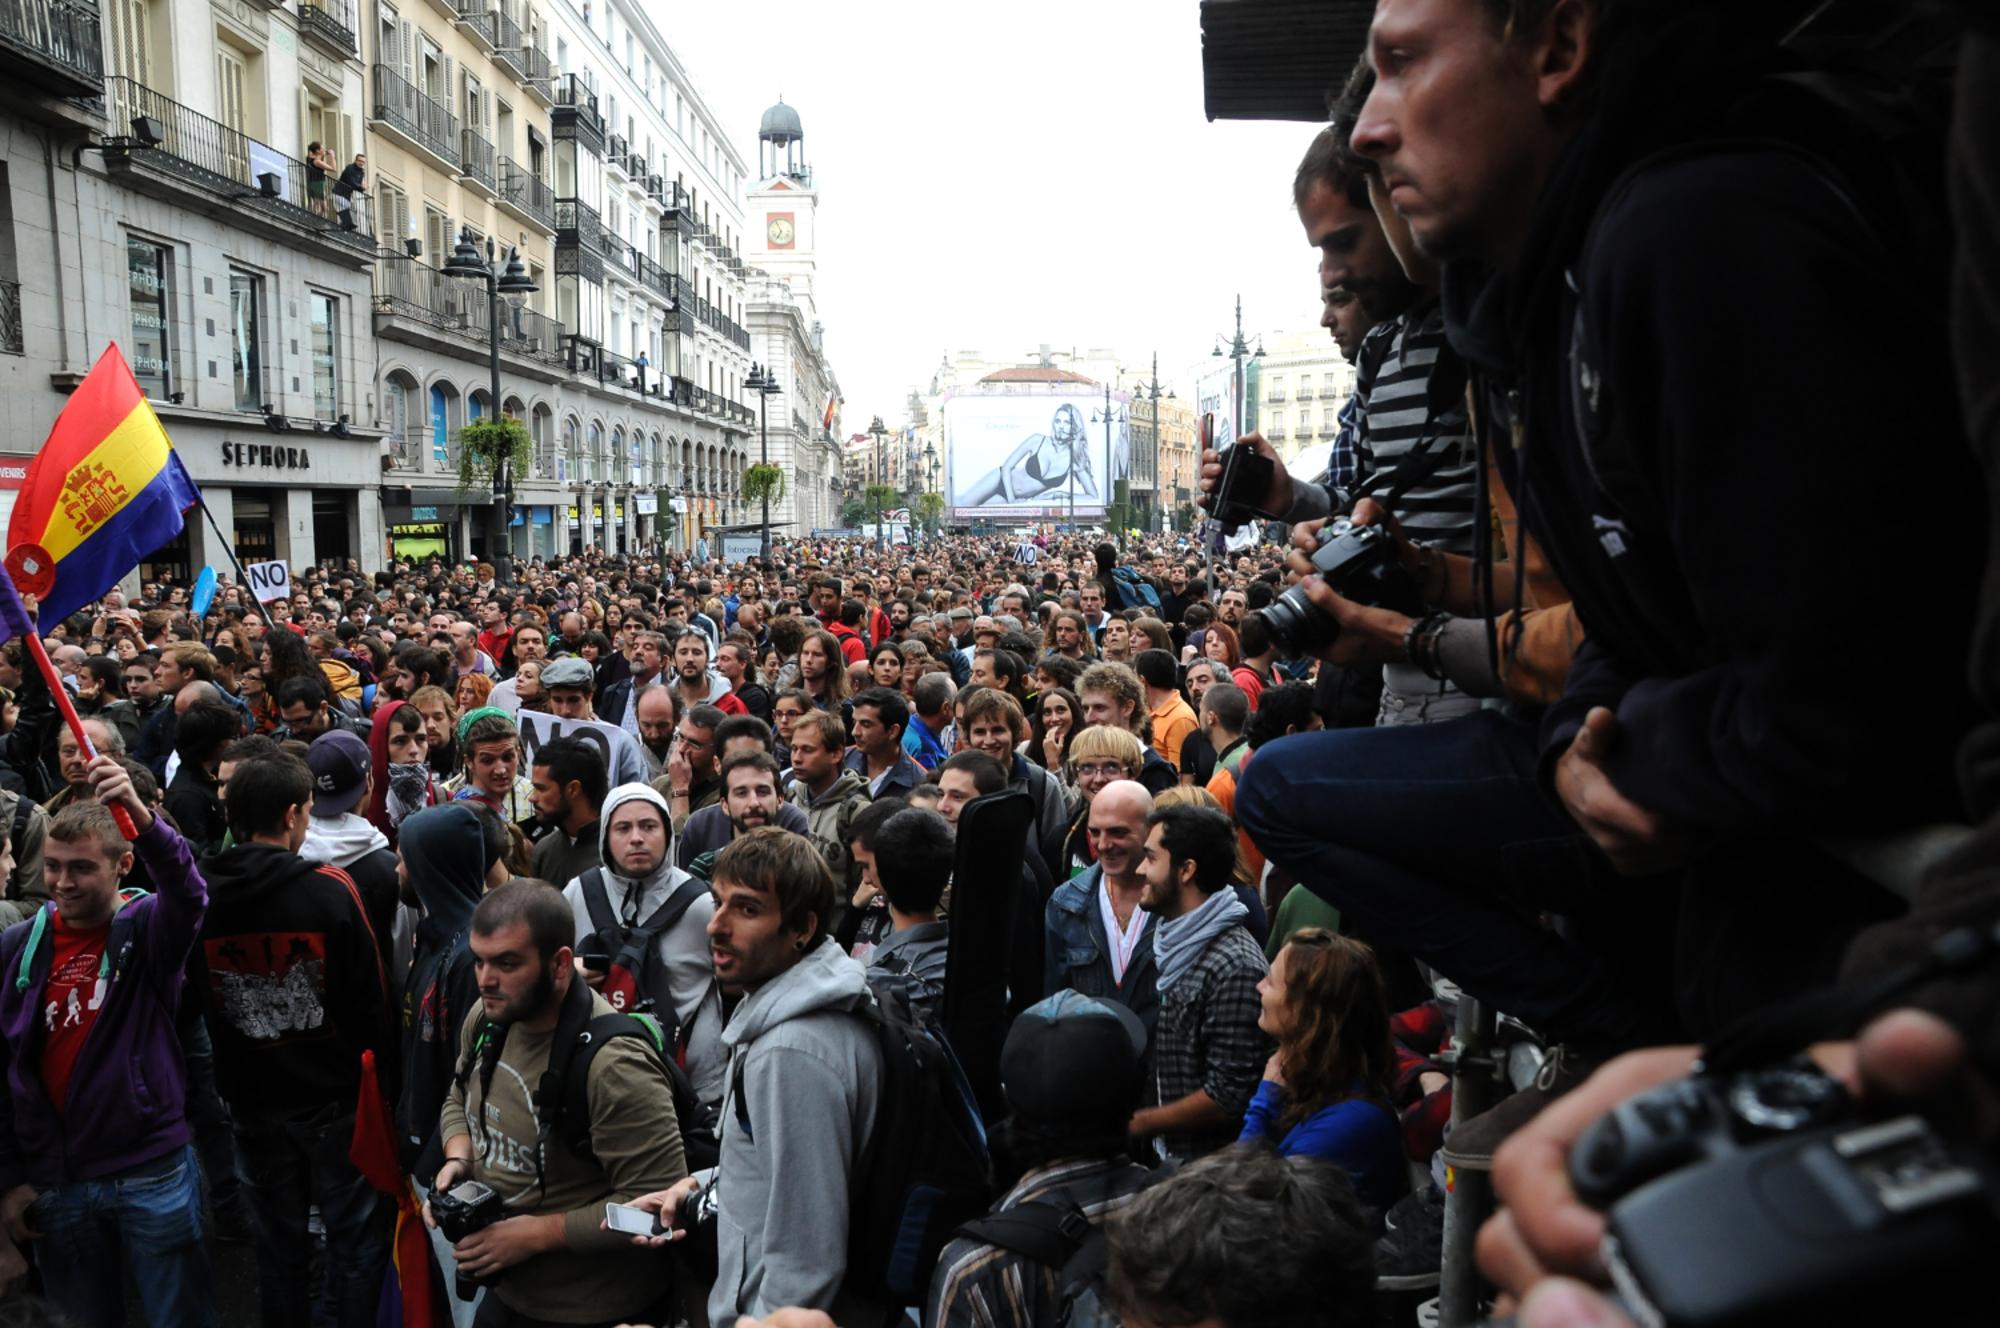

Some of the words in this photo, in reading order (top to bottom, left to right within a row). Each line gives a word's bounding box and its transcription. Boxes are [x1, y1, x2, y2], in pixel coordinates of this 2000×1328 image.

[222, 441, 310, 469] SEPHORA
[1014, 545, 1036, 564] NO
[250, 563, 286, 590] NO
[485, 1102, 501, 1121] THE
